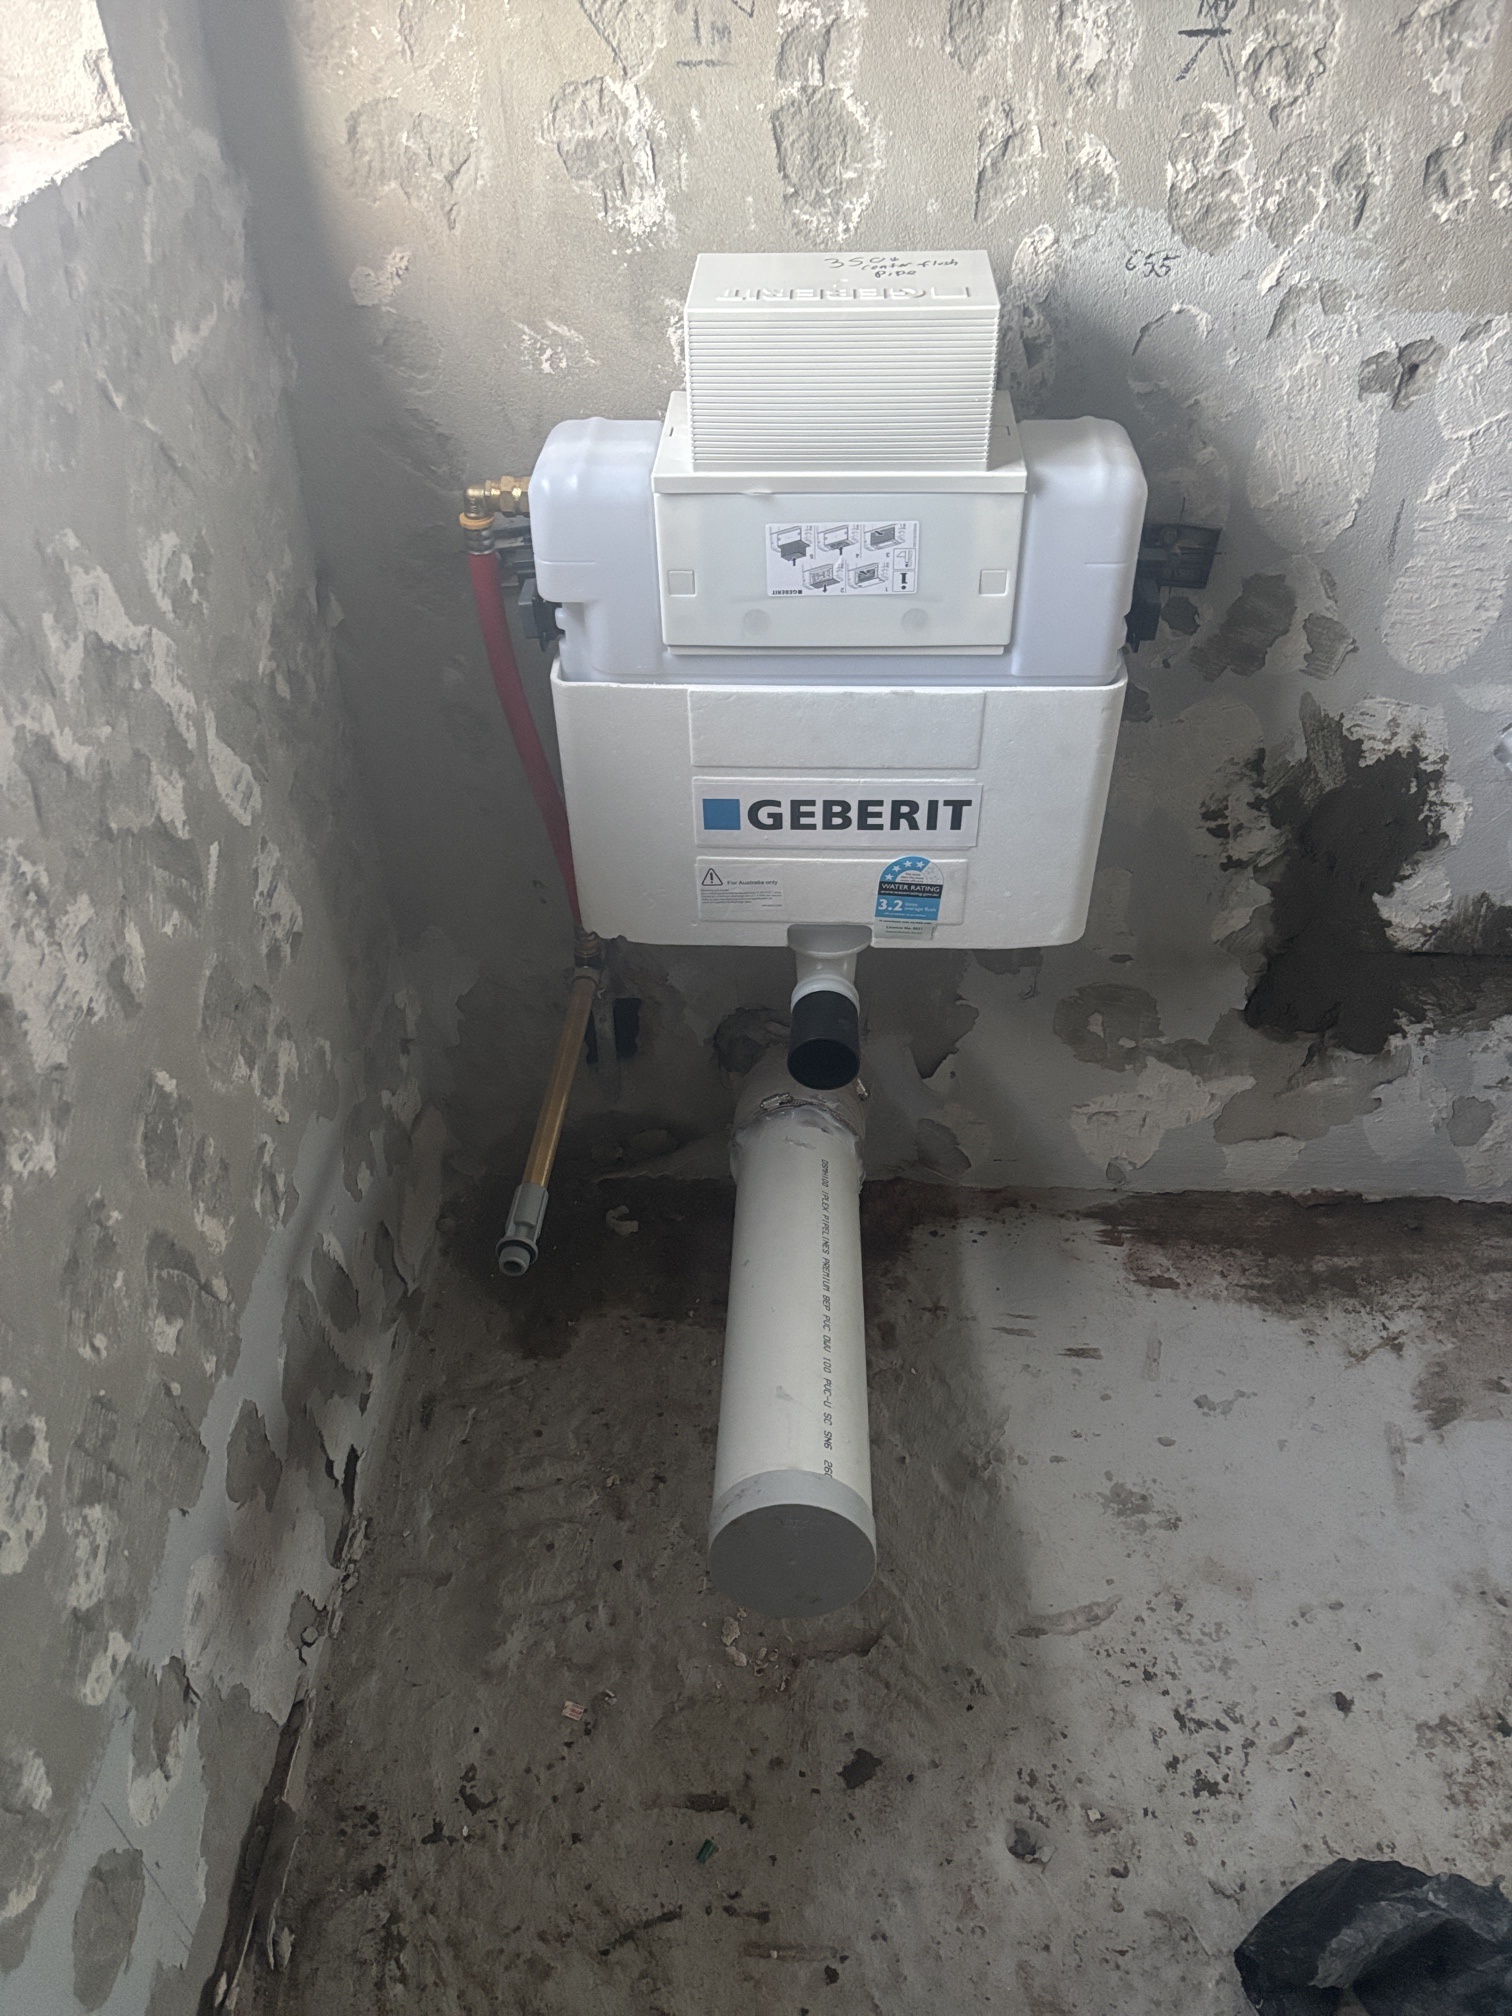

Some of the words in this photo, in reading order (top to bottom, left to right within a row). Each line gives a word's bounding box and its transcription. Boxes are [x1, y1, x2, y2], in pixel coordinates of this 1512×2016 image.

[747, 799, 972, 831] GEBERIT
[881, 883, 909, 891] WATER
[910, 885, 940, 893] RATING
[878, 898, 903, 911] 3.2
[821, 1190, 829, 1213] IPLEX
[821, 1214, 830, 1254] PIPELINES
[822, 1257, 830, 1292] PREMIUM
[822, 1294, 831, 1312] BEP
[822, 1314, 831, 1332] PVC
[822, 1335, 831, 1353] DWV
[823, 1357, 832, 1373] 100
[823, 1378, 832, 1408] PVC-U
[823, 1412, 833, 1426] SC
[823, 1430, 833, 1450] SN6
